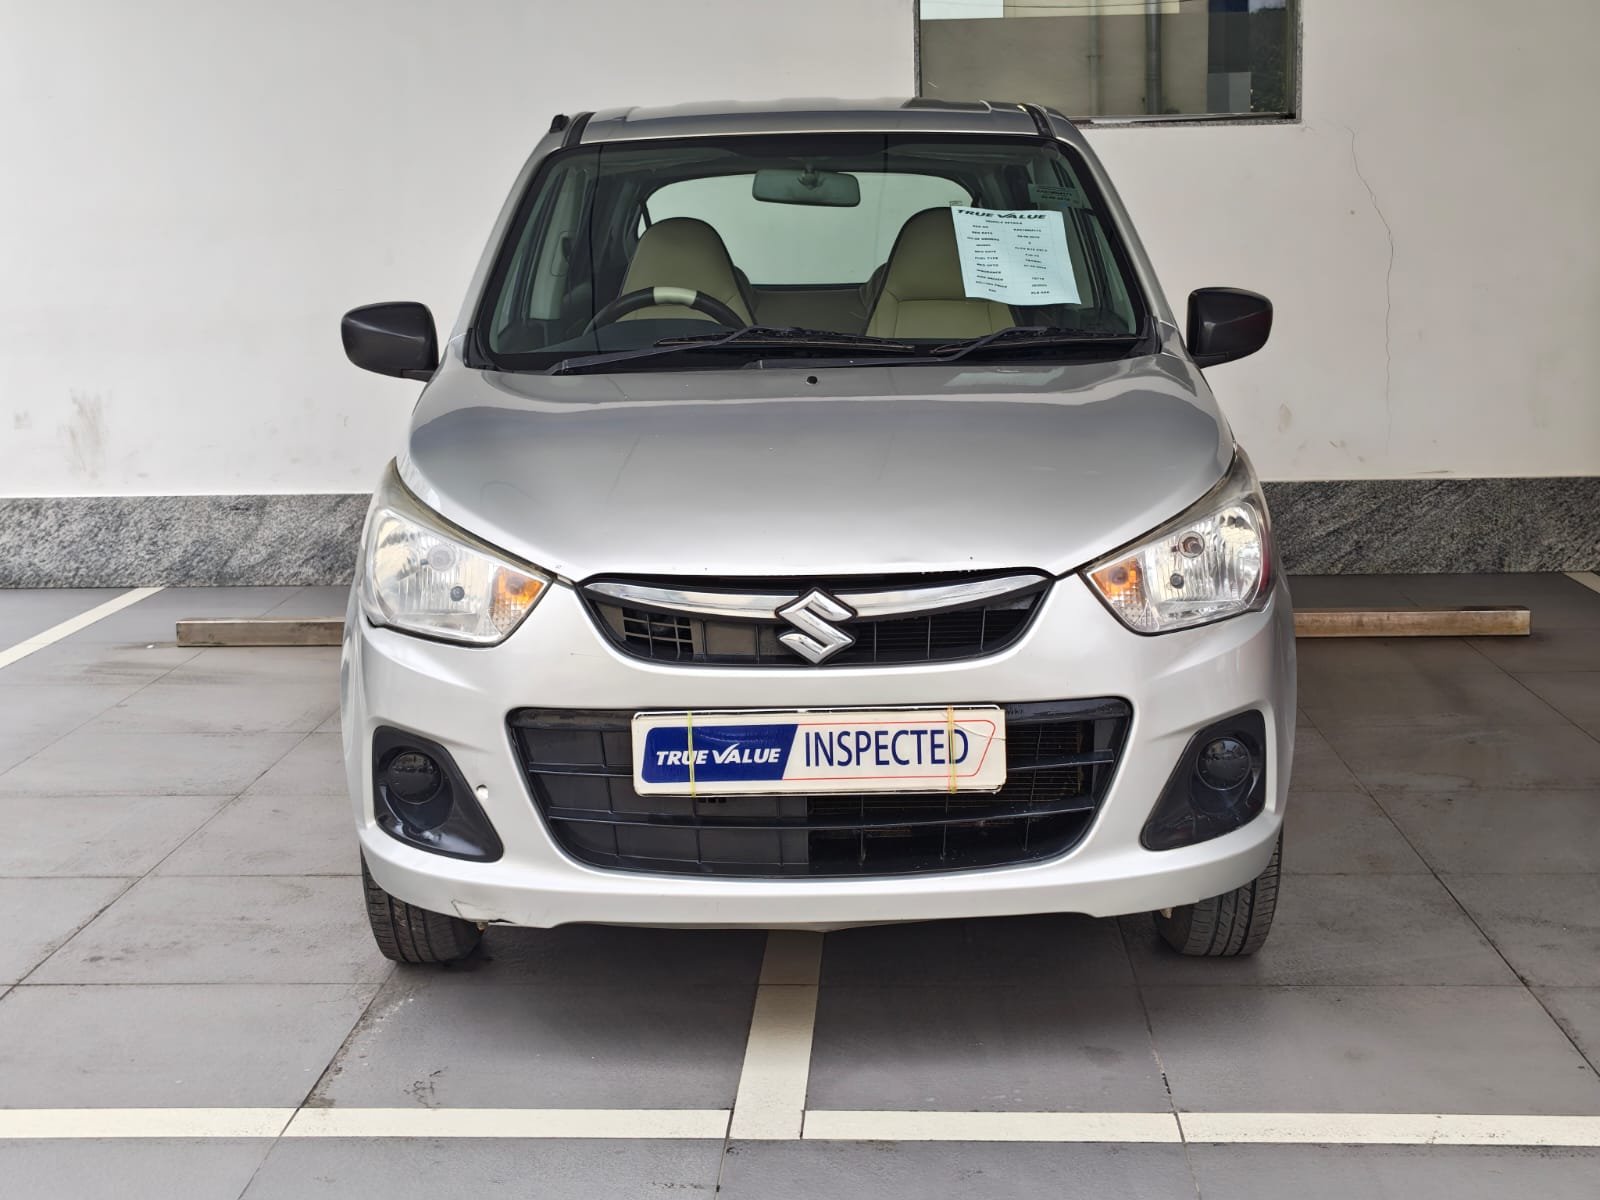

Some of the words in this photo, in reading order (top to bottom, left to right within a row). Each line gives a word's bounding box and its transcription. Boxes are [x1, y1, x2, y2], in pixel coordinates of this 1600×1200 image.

[957, 209, 995, 218] TRUE
[997, 212, 1048, 220] VALUE
[656, 750, 708, 765] TRUE
[712, 743, 782, 764] VALUE
[804, 728, 969, 768] INSPECTED
